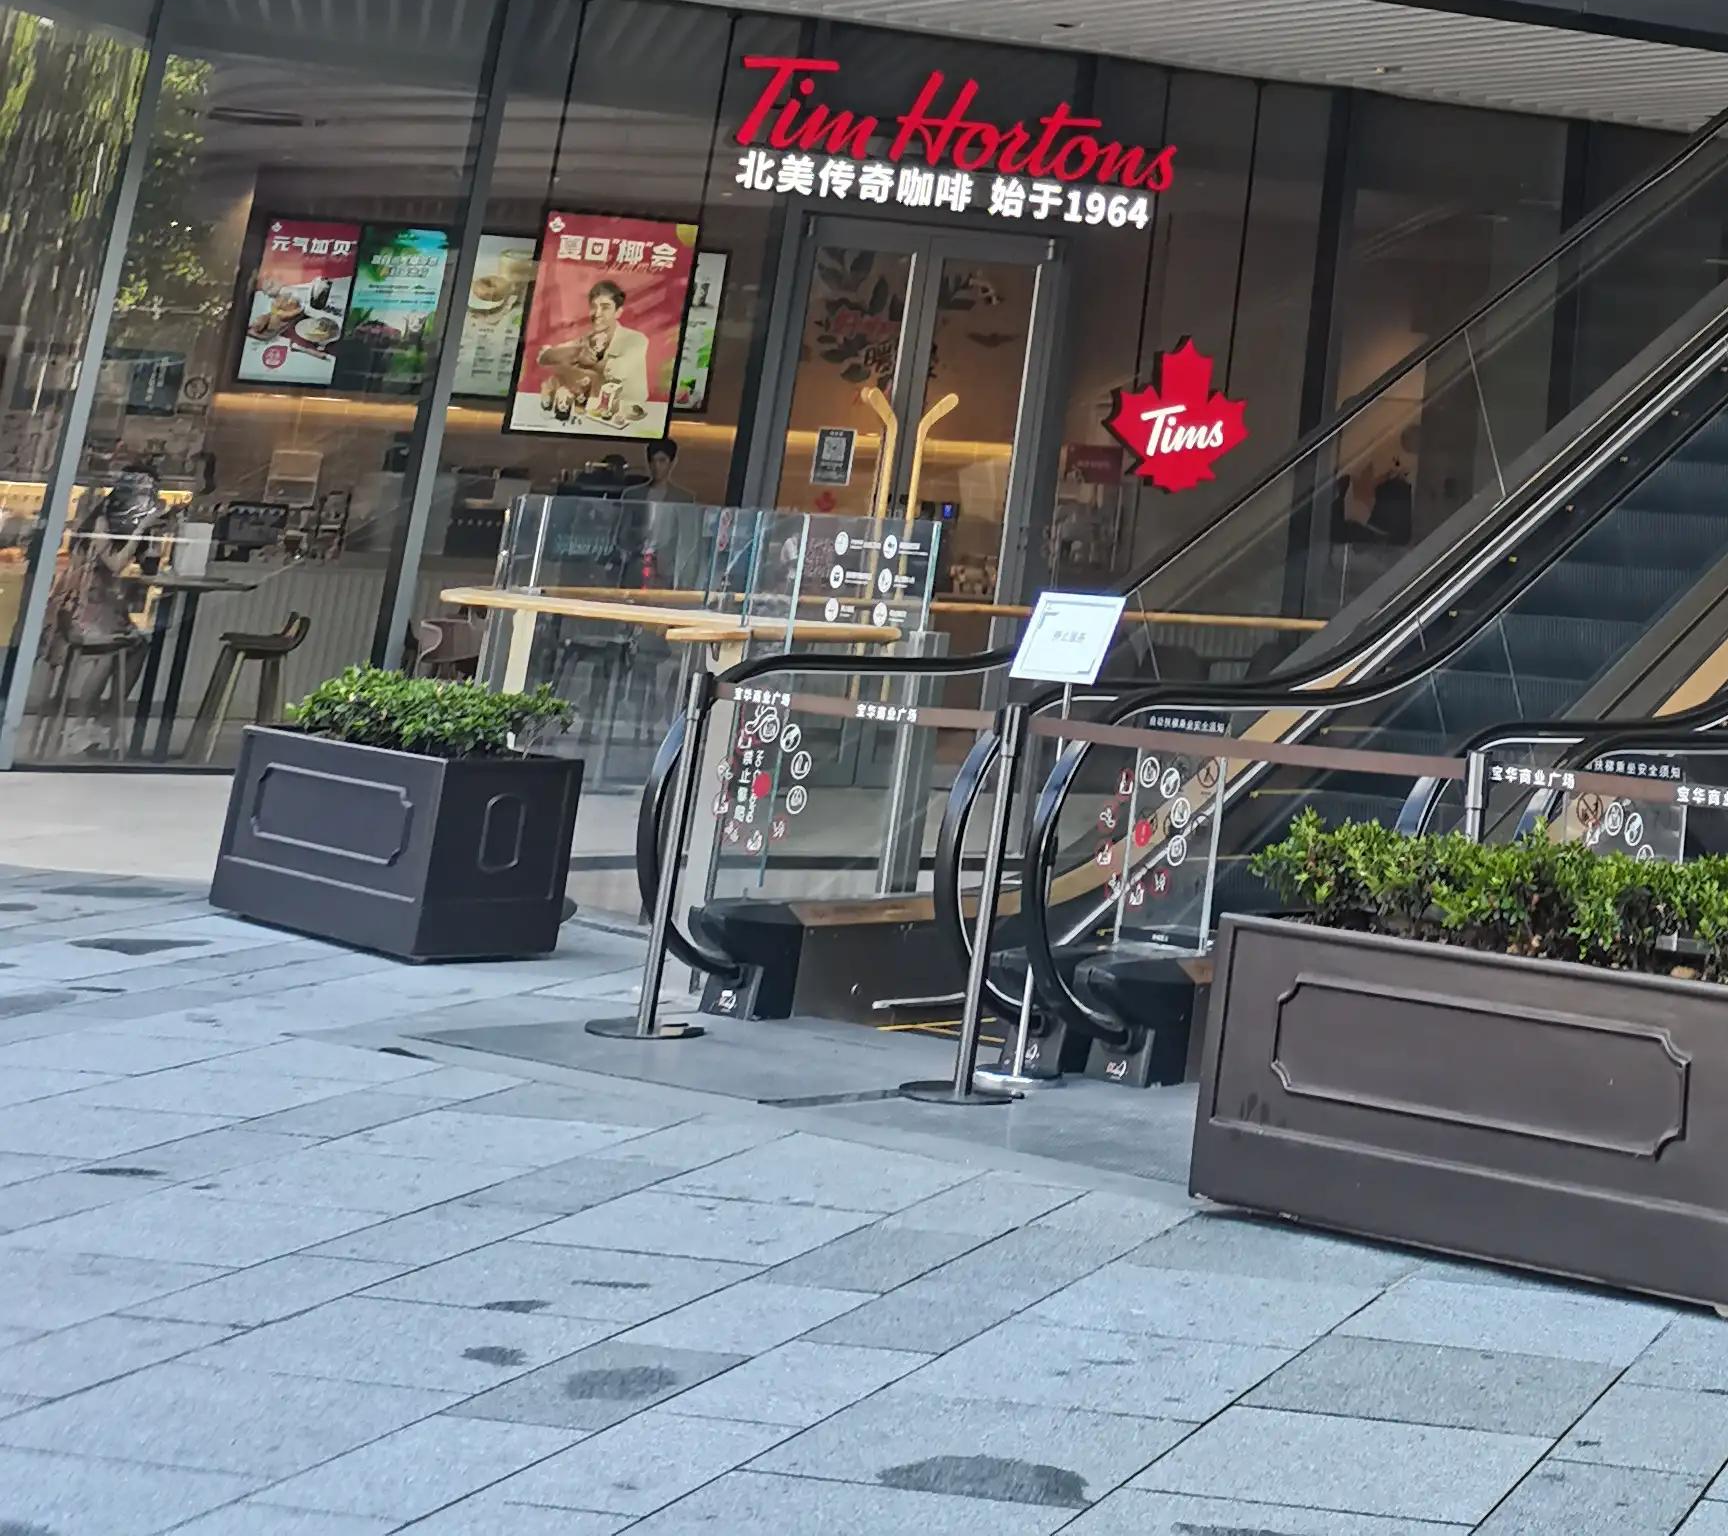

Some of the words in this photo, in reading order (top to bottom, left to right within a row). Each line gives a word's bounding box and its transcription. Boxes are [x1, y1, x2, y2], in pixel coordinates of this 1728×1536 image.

[735, 54, 880, 161] Tim
[888, 69, 1179, 193] Hortons
[734, 150, 976, 213] 北美传奇咖啡
[988, 175, 1150, 231] 始于1964
[1140, 403, 1224, 457] Tims
[732, 686, 792, 708] 宝华商业广场
[855, 703, 918, 724] 宝华商业广场
[1490, 765, 1576, 791] 宝华商业广场
